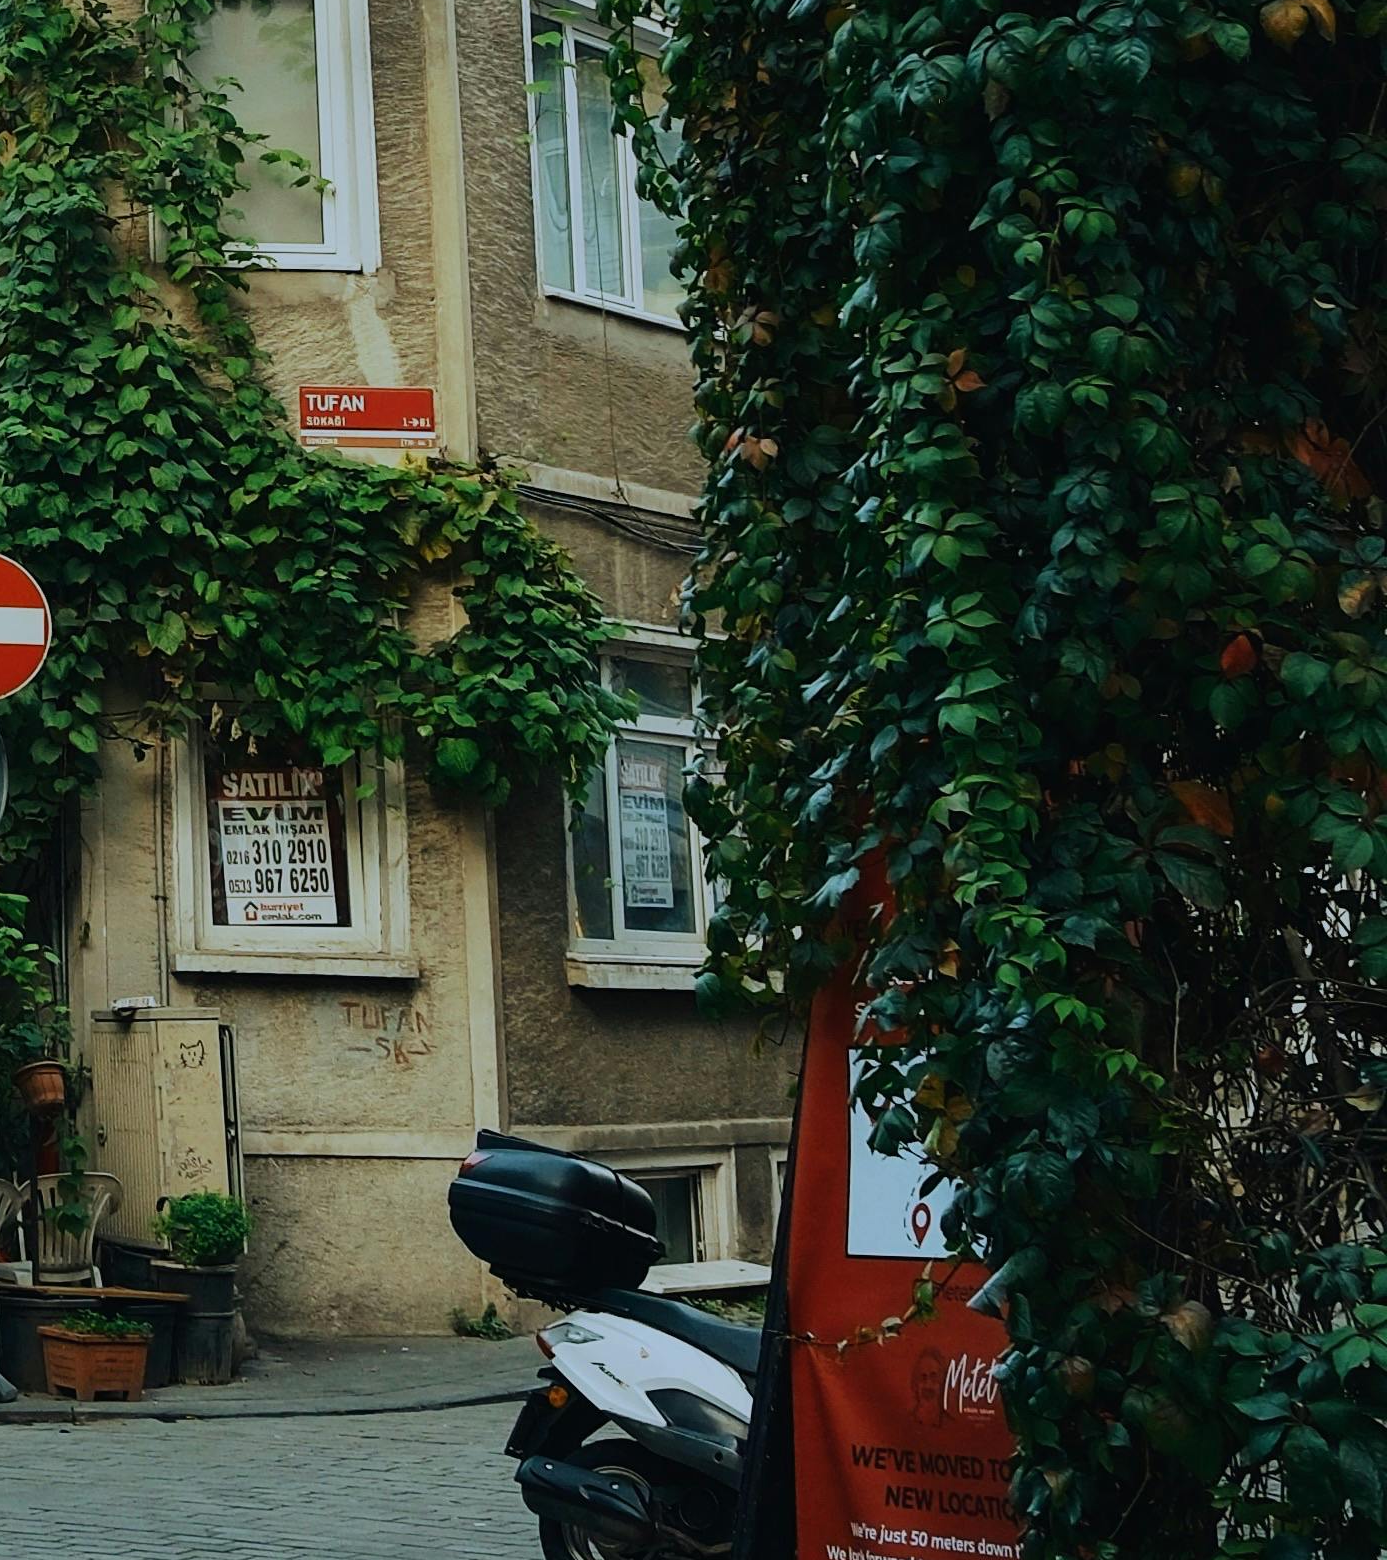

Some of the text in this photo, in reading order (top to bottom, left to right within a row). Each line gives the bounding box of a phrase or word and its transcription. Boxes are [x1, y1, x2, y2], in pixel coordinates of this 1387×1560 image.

[305, 394, 365, 412] TUFAN
[306, 415, 346, 427] SOKAĞI
[222, 771, 320, 798] SATILIK
[222, 803, 324, 821] EVİM
[224, 823, 324, 838] EMLAK İNŞAAT
[227, 839, 327, 865] 0216 310 2910
[229, 868, 330, 894] 0533 967 6250
[338, 1001, 432, 1034] TUFAN
[943, 1353, 998, 1414] Metet
[851, 1444, 916, 1473] WE'VE
[920, 1453, 984, 1482] MOVED
[885, 1485, 1018, 1522] NEW LOCATIO
[850, 1522, 877, 1541] We're
[877, 1523, 908, 1545] just
[909, 1530, 928, 1548] 50
[930, 1535, 975, 1554] meters
[977, 1537, 1012, 1559] down
